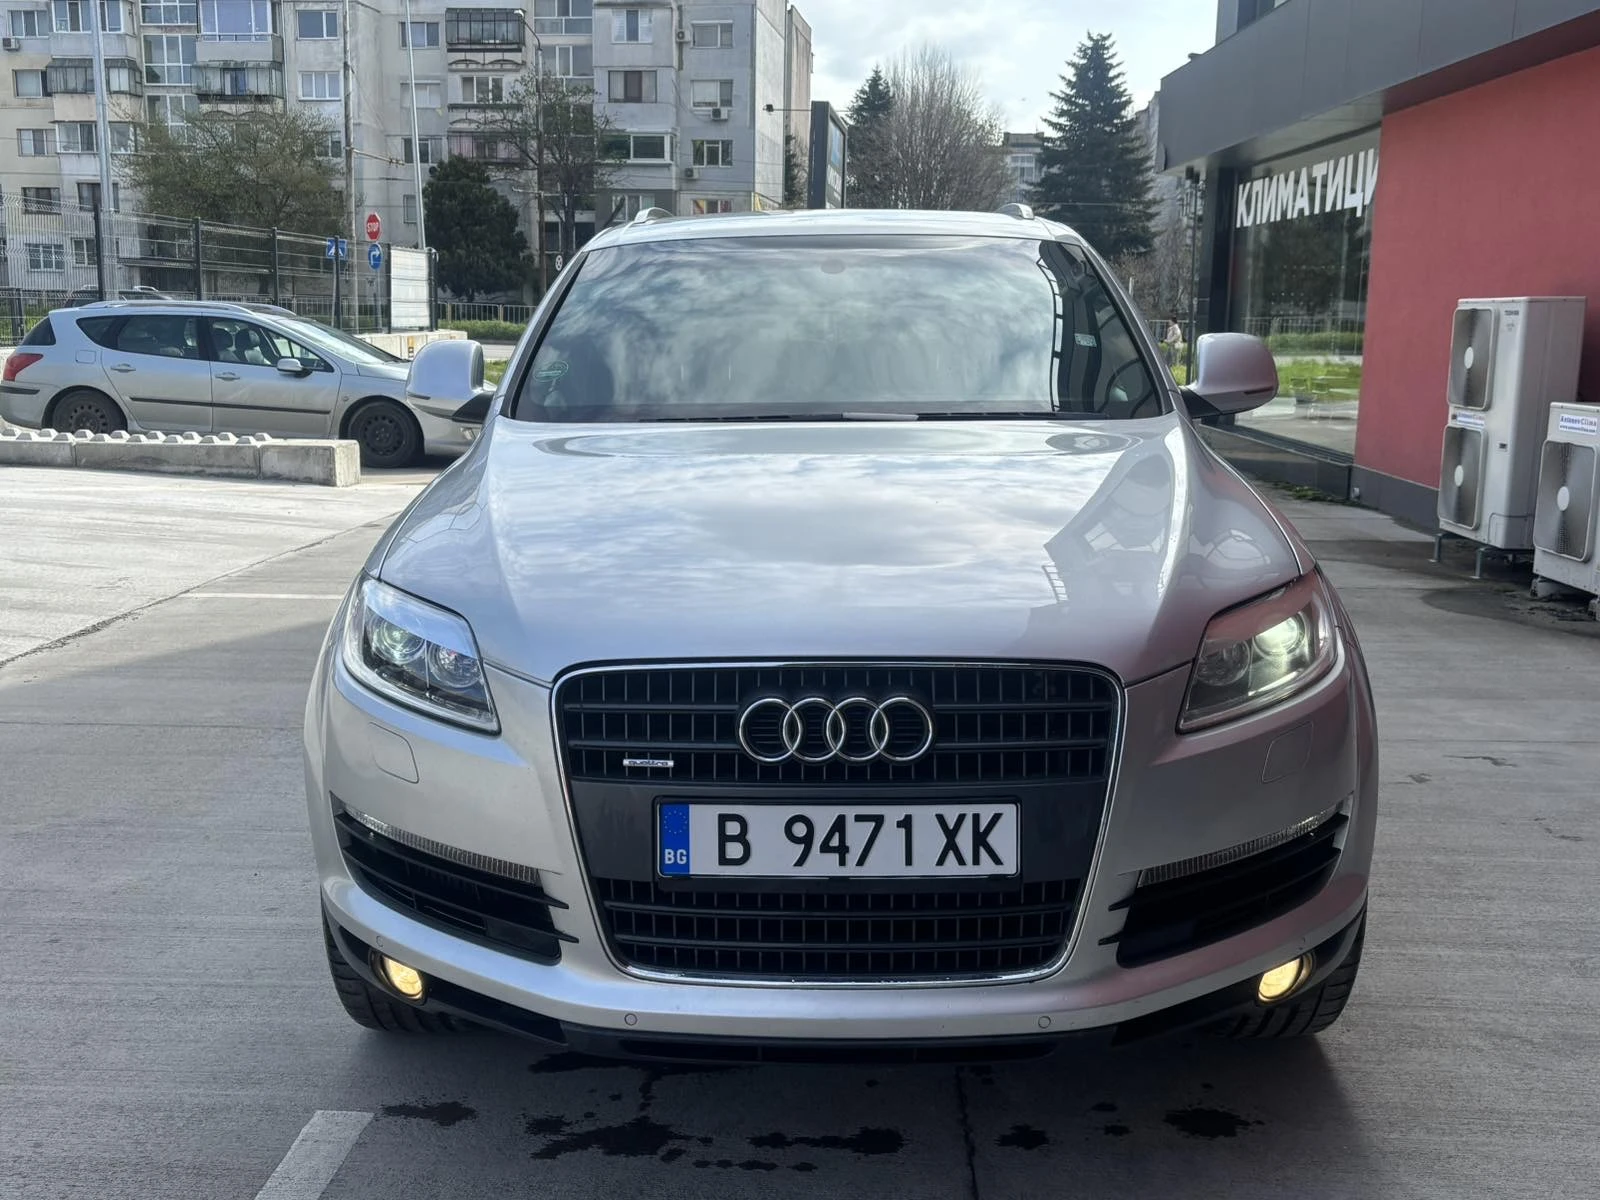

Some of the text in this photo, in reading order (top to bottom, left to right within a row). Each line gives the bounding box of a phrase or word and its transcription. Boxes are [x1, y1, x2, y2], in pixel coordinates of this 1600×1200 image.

[367, 222, 379, 232] STOP
[717, 812, 1004, 867] B 9471 XK
[664, 848, 688, 865] BG
